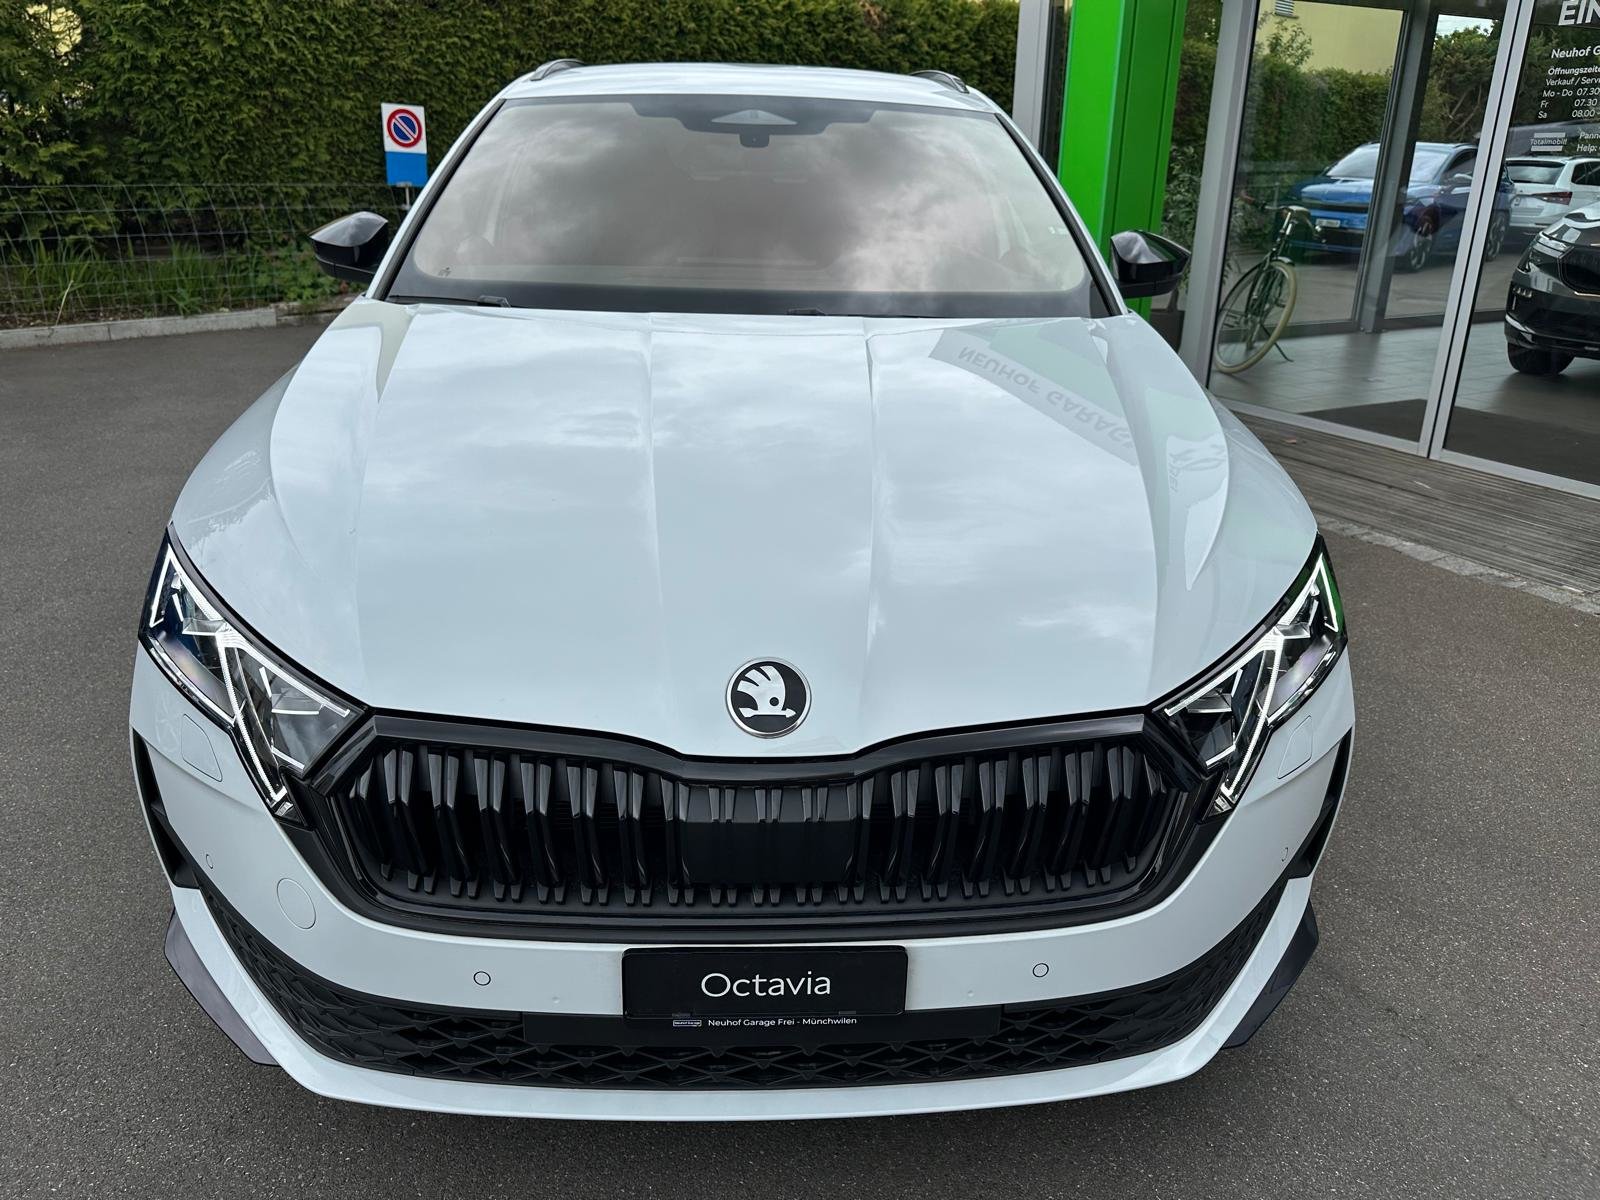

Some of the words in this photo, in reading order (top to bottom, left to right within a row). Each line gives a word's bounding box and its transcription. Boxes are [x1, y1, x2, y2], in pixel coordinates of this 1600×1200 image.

[1551, 45, 1591, 59] Neuhof
[1545, 78, 1574, 86] Verkauf
[1542, 90, 1555, 98] Mo
[1561, 88, 1573, 97] Do
[1540, 100, 1549, 109] Fr
[1574, 98, 1598, 107] 07.30
[1538, 111, 1548, 119] Sa
[701, 971, 831, 997] Octavia
[708, 1019, 742, 1027] Neuhof
[743, 1019, 776, 1028] Garage
[778, 1018, 795, 1026] Frei
[802, 1017, 857, 1026] Münchwilen
